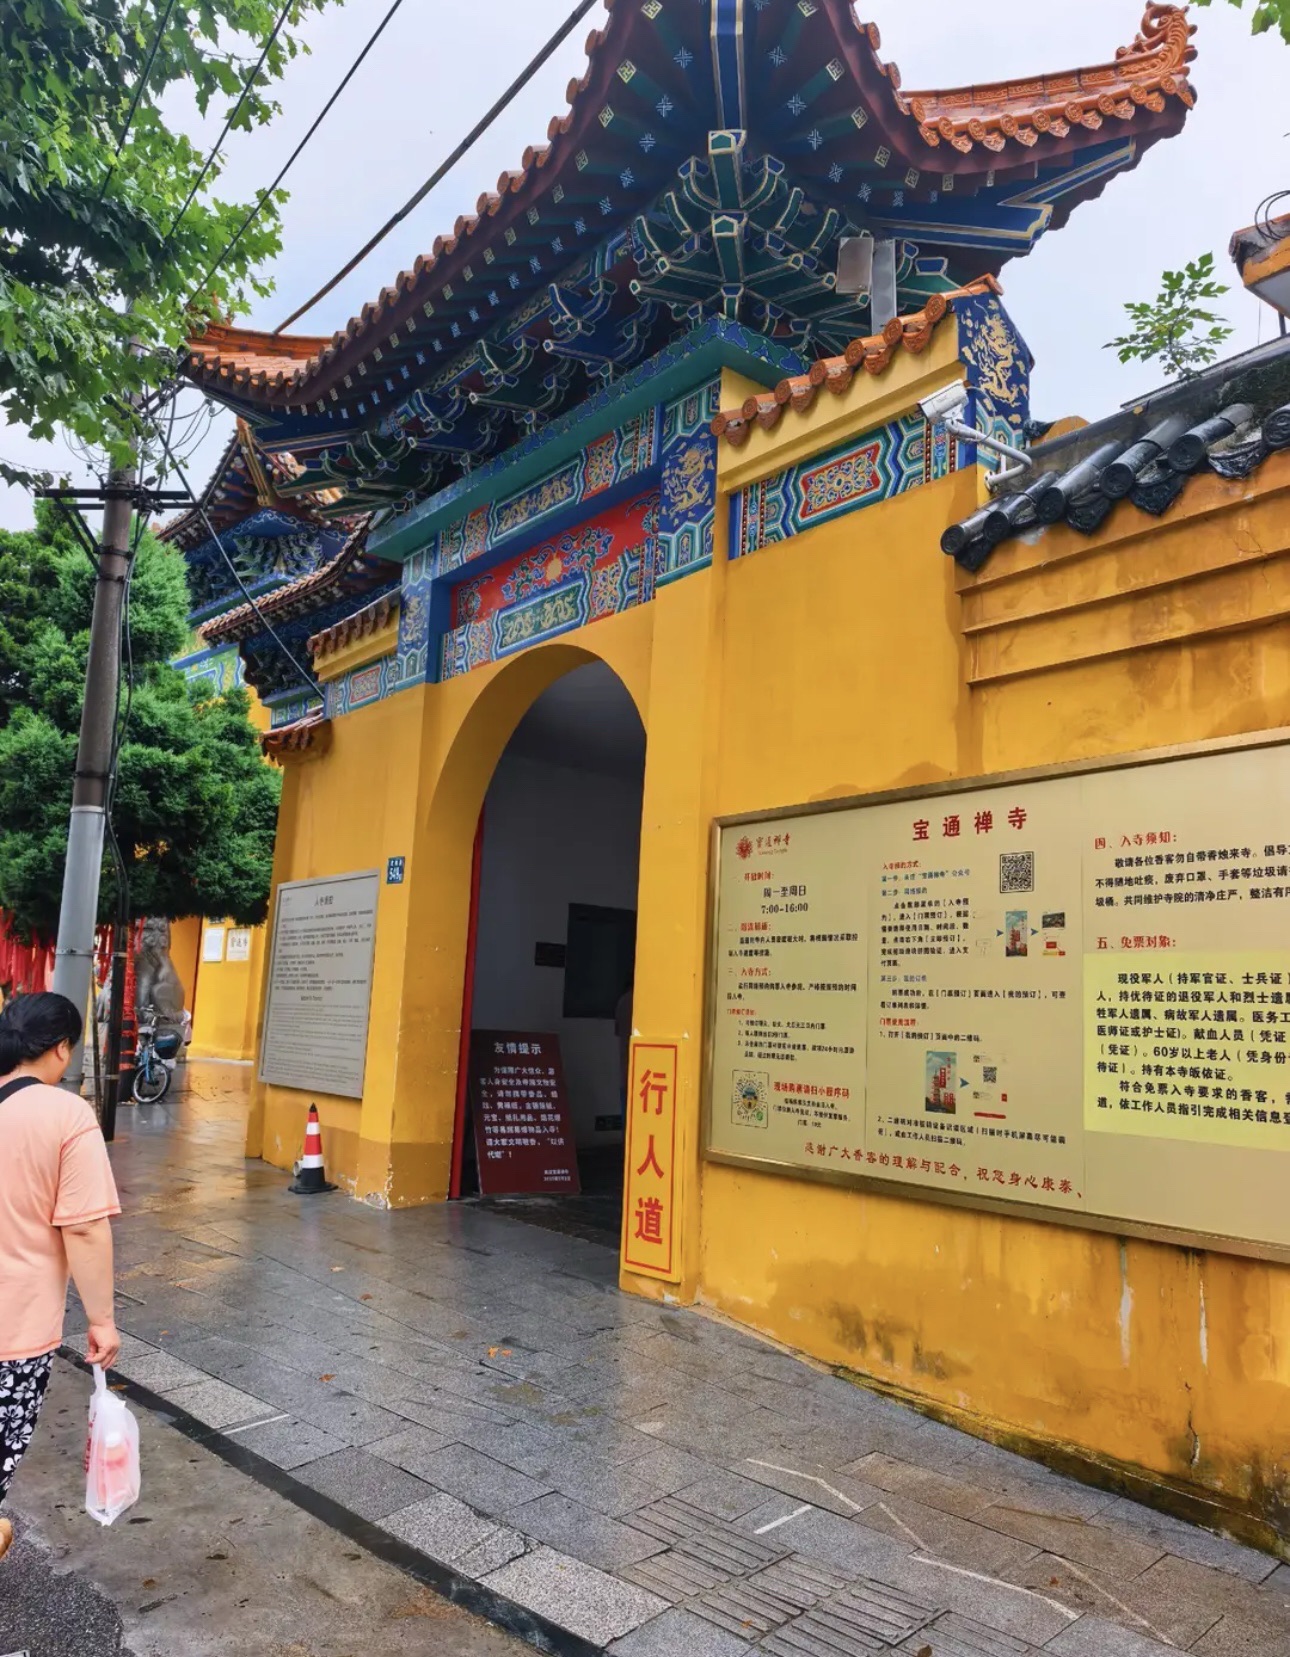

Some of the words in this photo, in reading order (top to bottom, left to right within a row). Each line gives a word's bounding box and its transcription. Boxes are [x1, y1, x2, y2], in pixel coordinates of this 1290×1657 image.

[912, 806, 1027, 841] 宝通禅寺
[1094, 831, 1177, 850] 四、入寺须知：
[1114, 844, 1290, 869] 敬请各位香客勿自带香烛来寺。倡导
[1095, 865, 1290, 889] 不得随地吐痰，废弃口罩、手套等垃圾请
[761, 902, 809, 915] 7:00-16:00
[1097, 934, 1176, 950] 五、免票对象：
[494, 1042, 542, 1055] 友情提示
[1101, 1043, 1290, 1065] （凭证）。60岁以上老人（凭身份
[634, 1069, 667, 1245] 行人道
